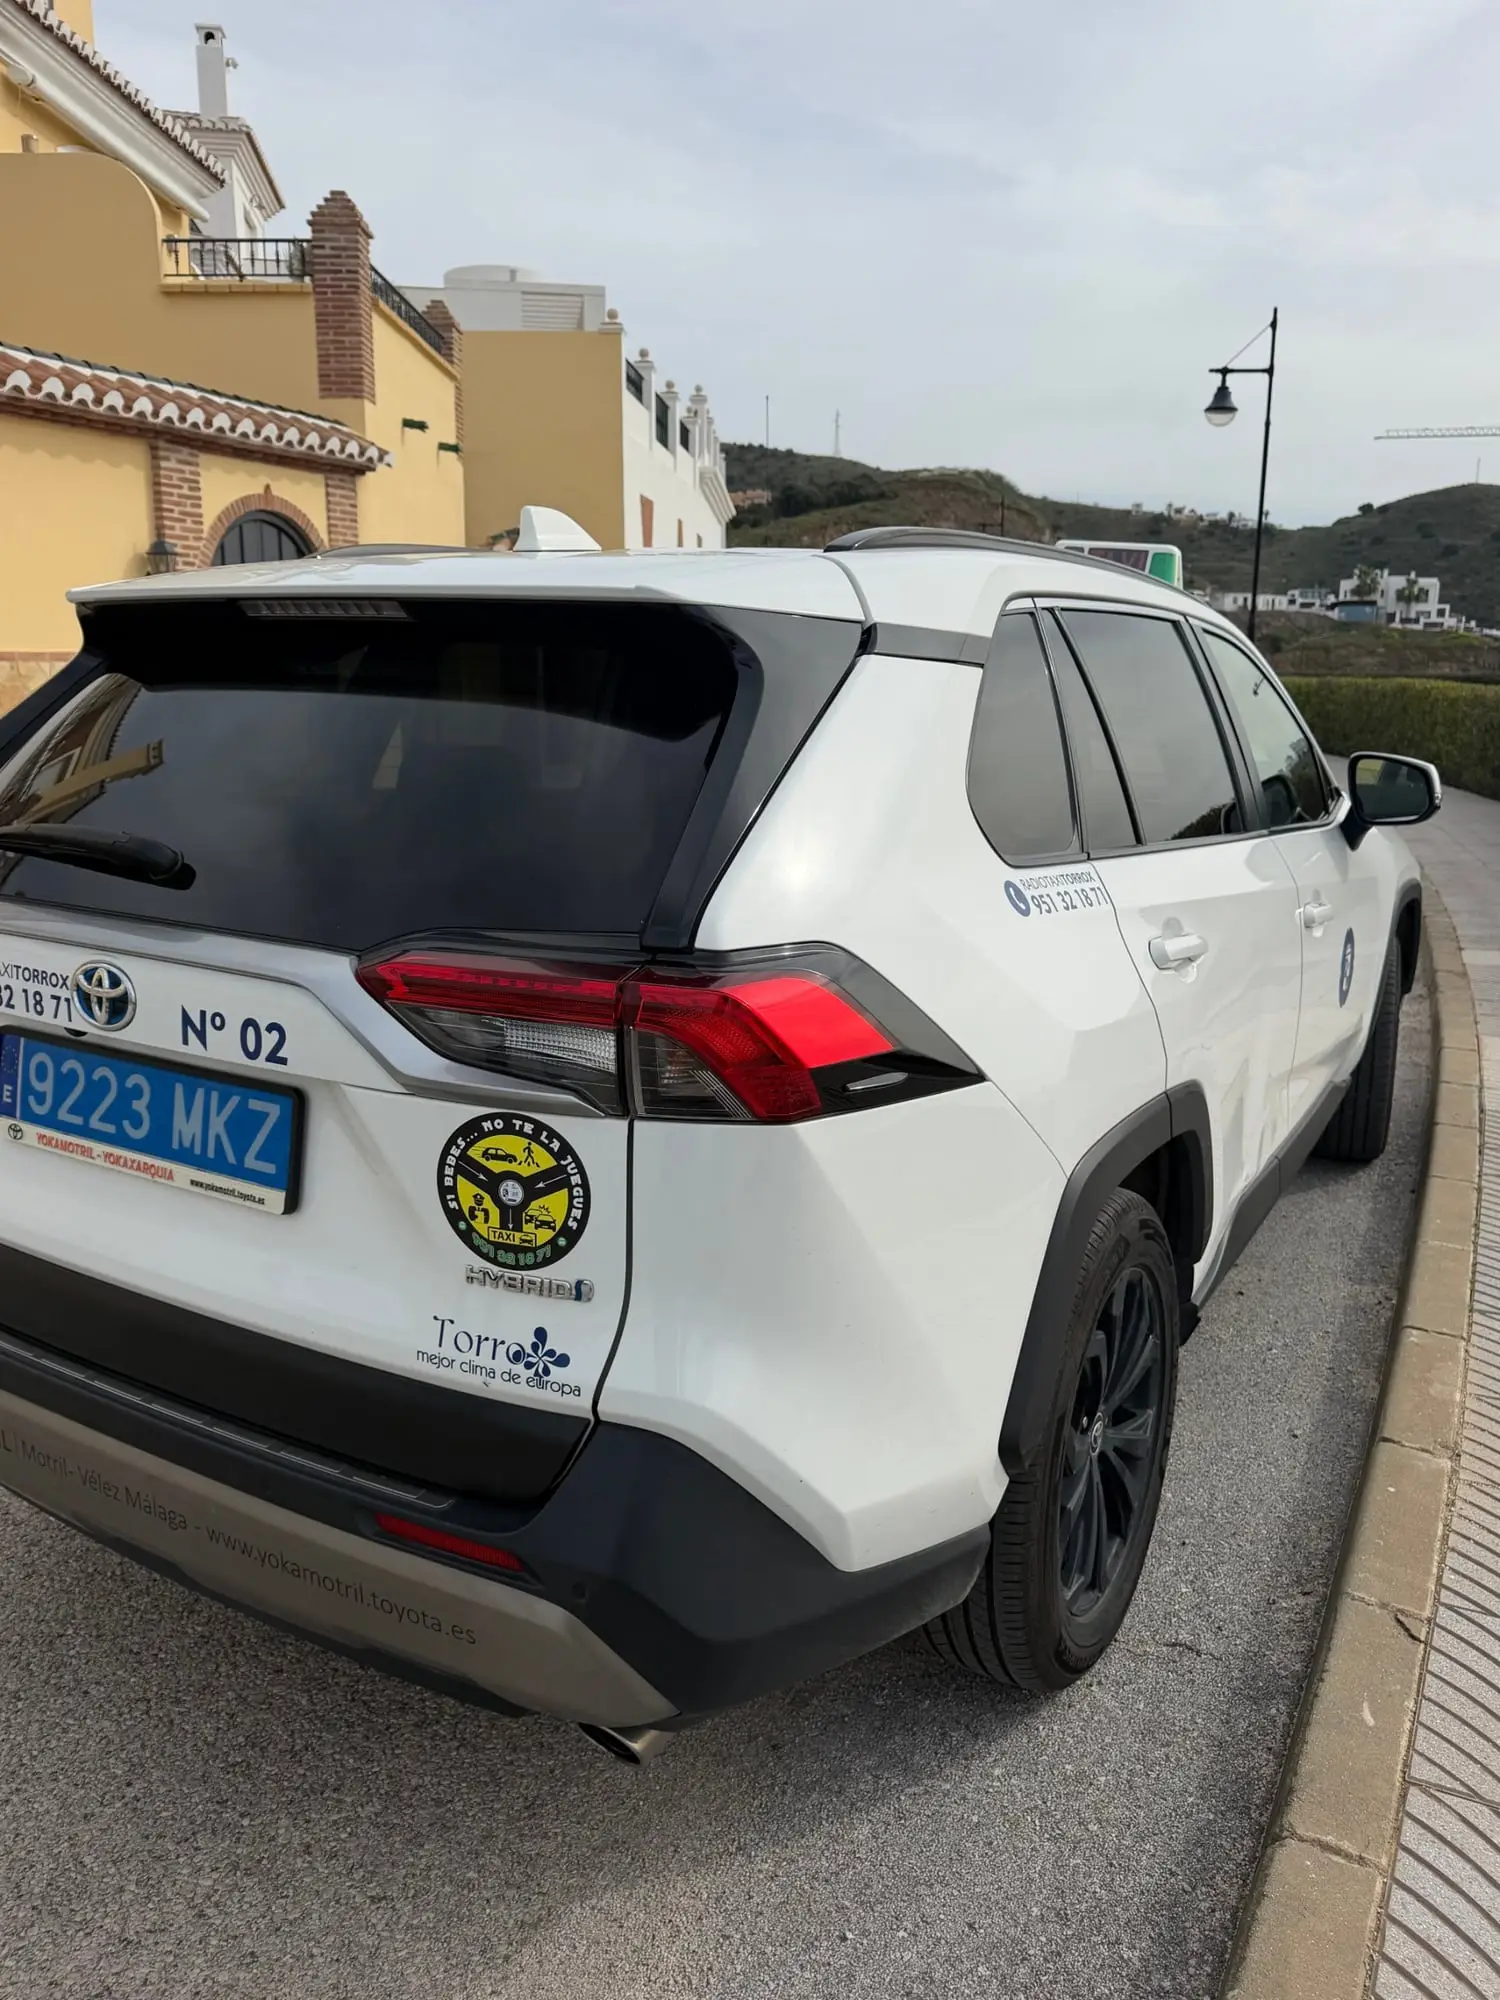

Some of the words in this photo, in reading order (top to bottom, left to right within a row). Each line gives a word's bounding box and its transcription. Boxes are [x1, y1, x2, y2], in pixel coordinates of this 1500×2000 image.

[1019, 871, 1096, 891] RADIOTAXITORROX
[1031, 893, 1059, 915] 951
[1056, 890, 1078, 911] 32
[1074, 888, 1093, 908] 18
[0, 962, 69, 990] XITORROX
[22, 988, 44, 1016] 18
[50, 994, 72, 1022] 71
[240, 1017, 289, 1066] 02
[2, 1083, 12, 1103] E
[28, 1052, 152, 1140] 9223
[172, 1082, 281, 1175] MKZ
[36, 1132, 95, 1160] YOKAMOTRIL
[103, 1151, 174, 1182] YOKAXARQUIA
[443, 1194, 459, 1210] SI
[481, 1118, 504, 1133] NO
[512, 1119, 535, 1134] TE
[540, 1131, 561, 1152] LA
[560, 1155, 584, 1230] JUEGUES
[491, 1229, 516, 1243] TAXI
[465, 1265, 573, 1300] HYBRID
[416, 1350, 456, 1369] mejor
[460, 1360, 496, 1379] clima
[501, 1369, 521, 1385] de
[526, 1375, 581, 1397] europa
[77, 1466, 121, 1501] Vélez
[125, 1487, 188, 1530] Málaga
[206, 1526, 476, 1645] www.yokamotril.toyota.es
